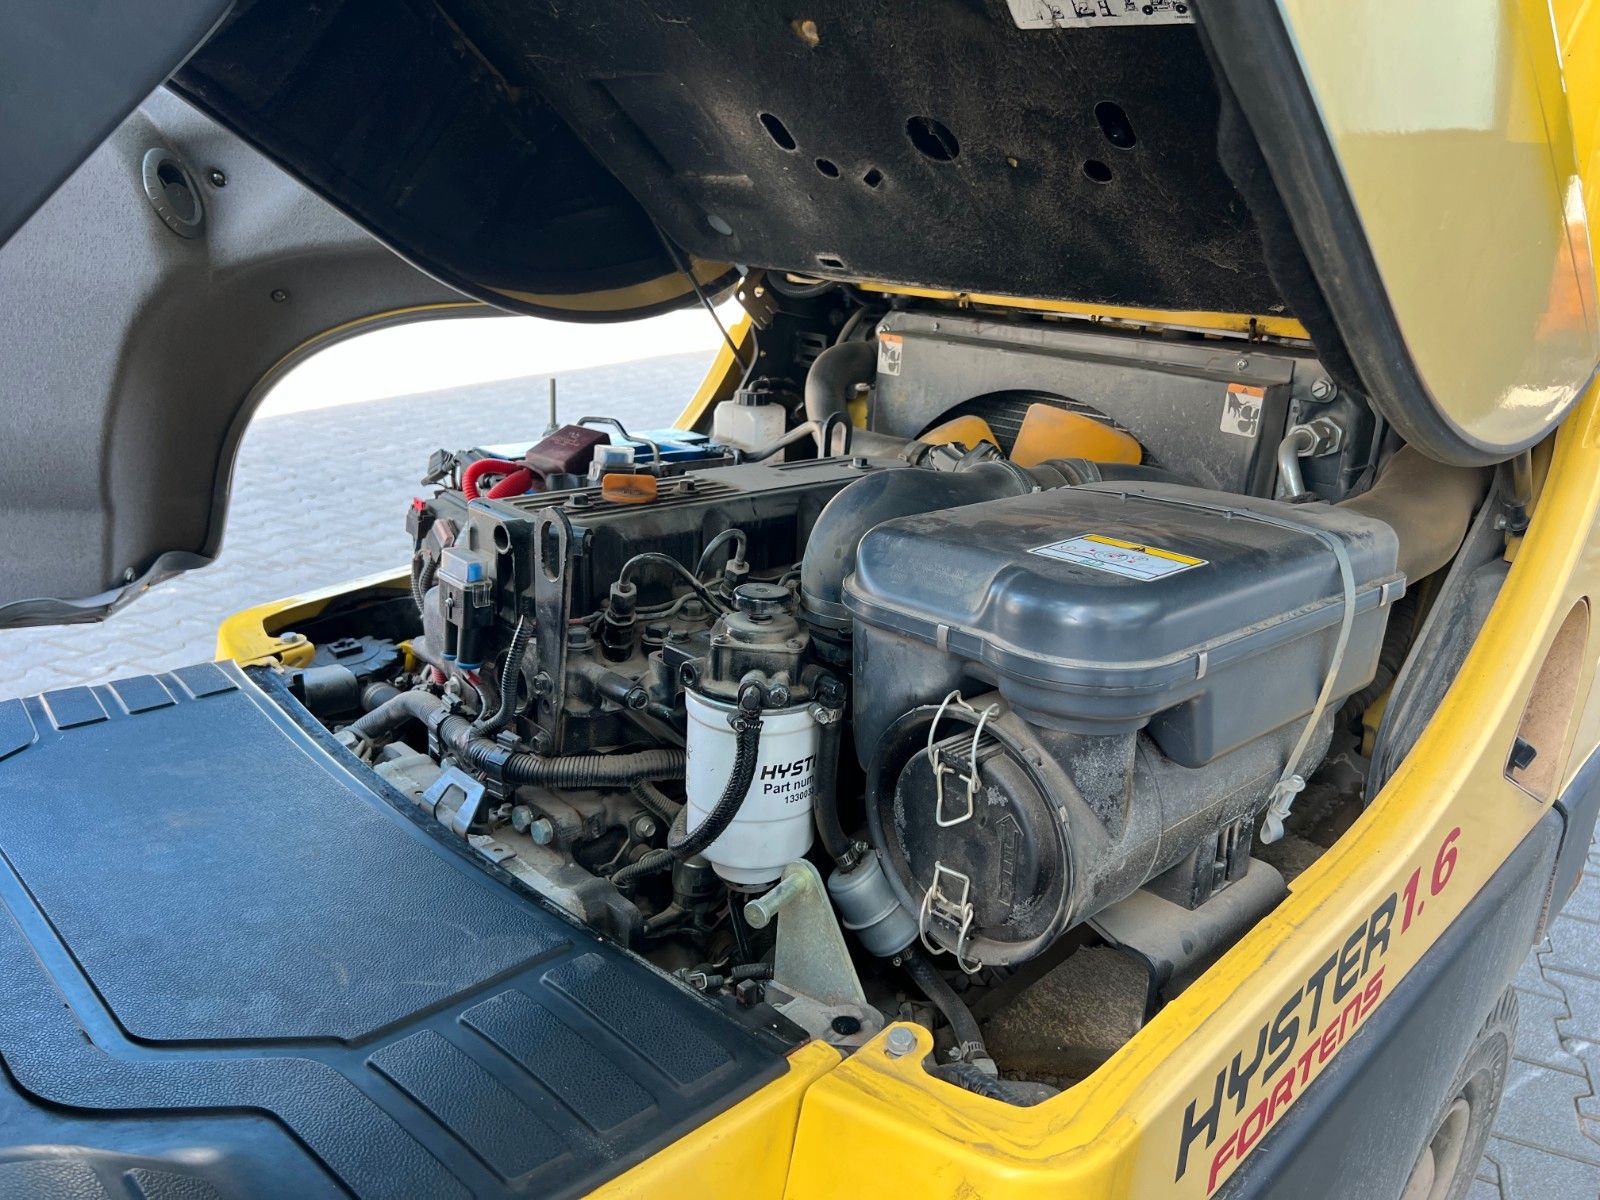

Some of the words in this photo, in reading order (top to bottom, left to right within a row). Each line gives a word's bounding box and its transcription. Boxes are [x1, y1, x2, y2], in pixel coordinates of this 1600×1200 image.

[760, 753, 817, 780] HYST
[763, 782, 790, 795] Part
[1175, 891, 1397, 1184] HYSTER
[1400, 827, 1461, 936] 1.6
[1206, 964, 1386, 1196] FORTENS
